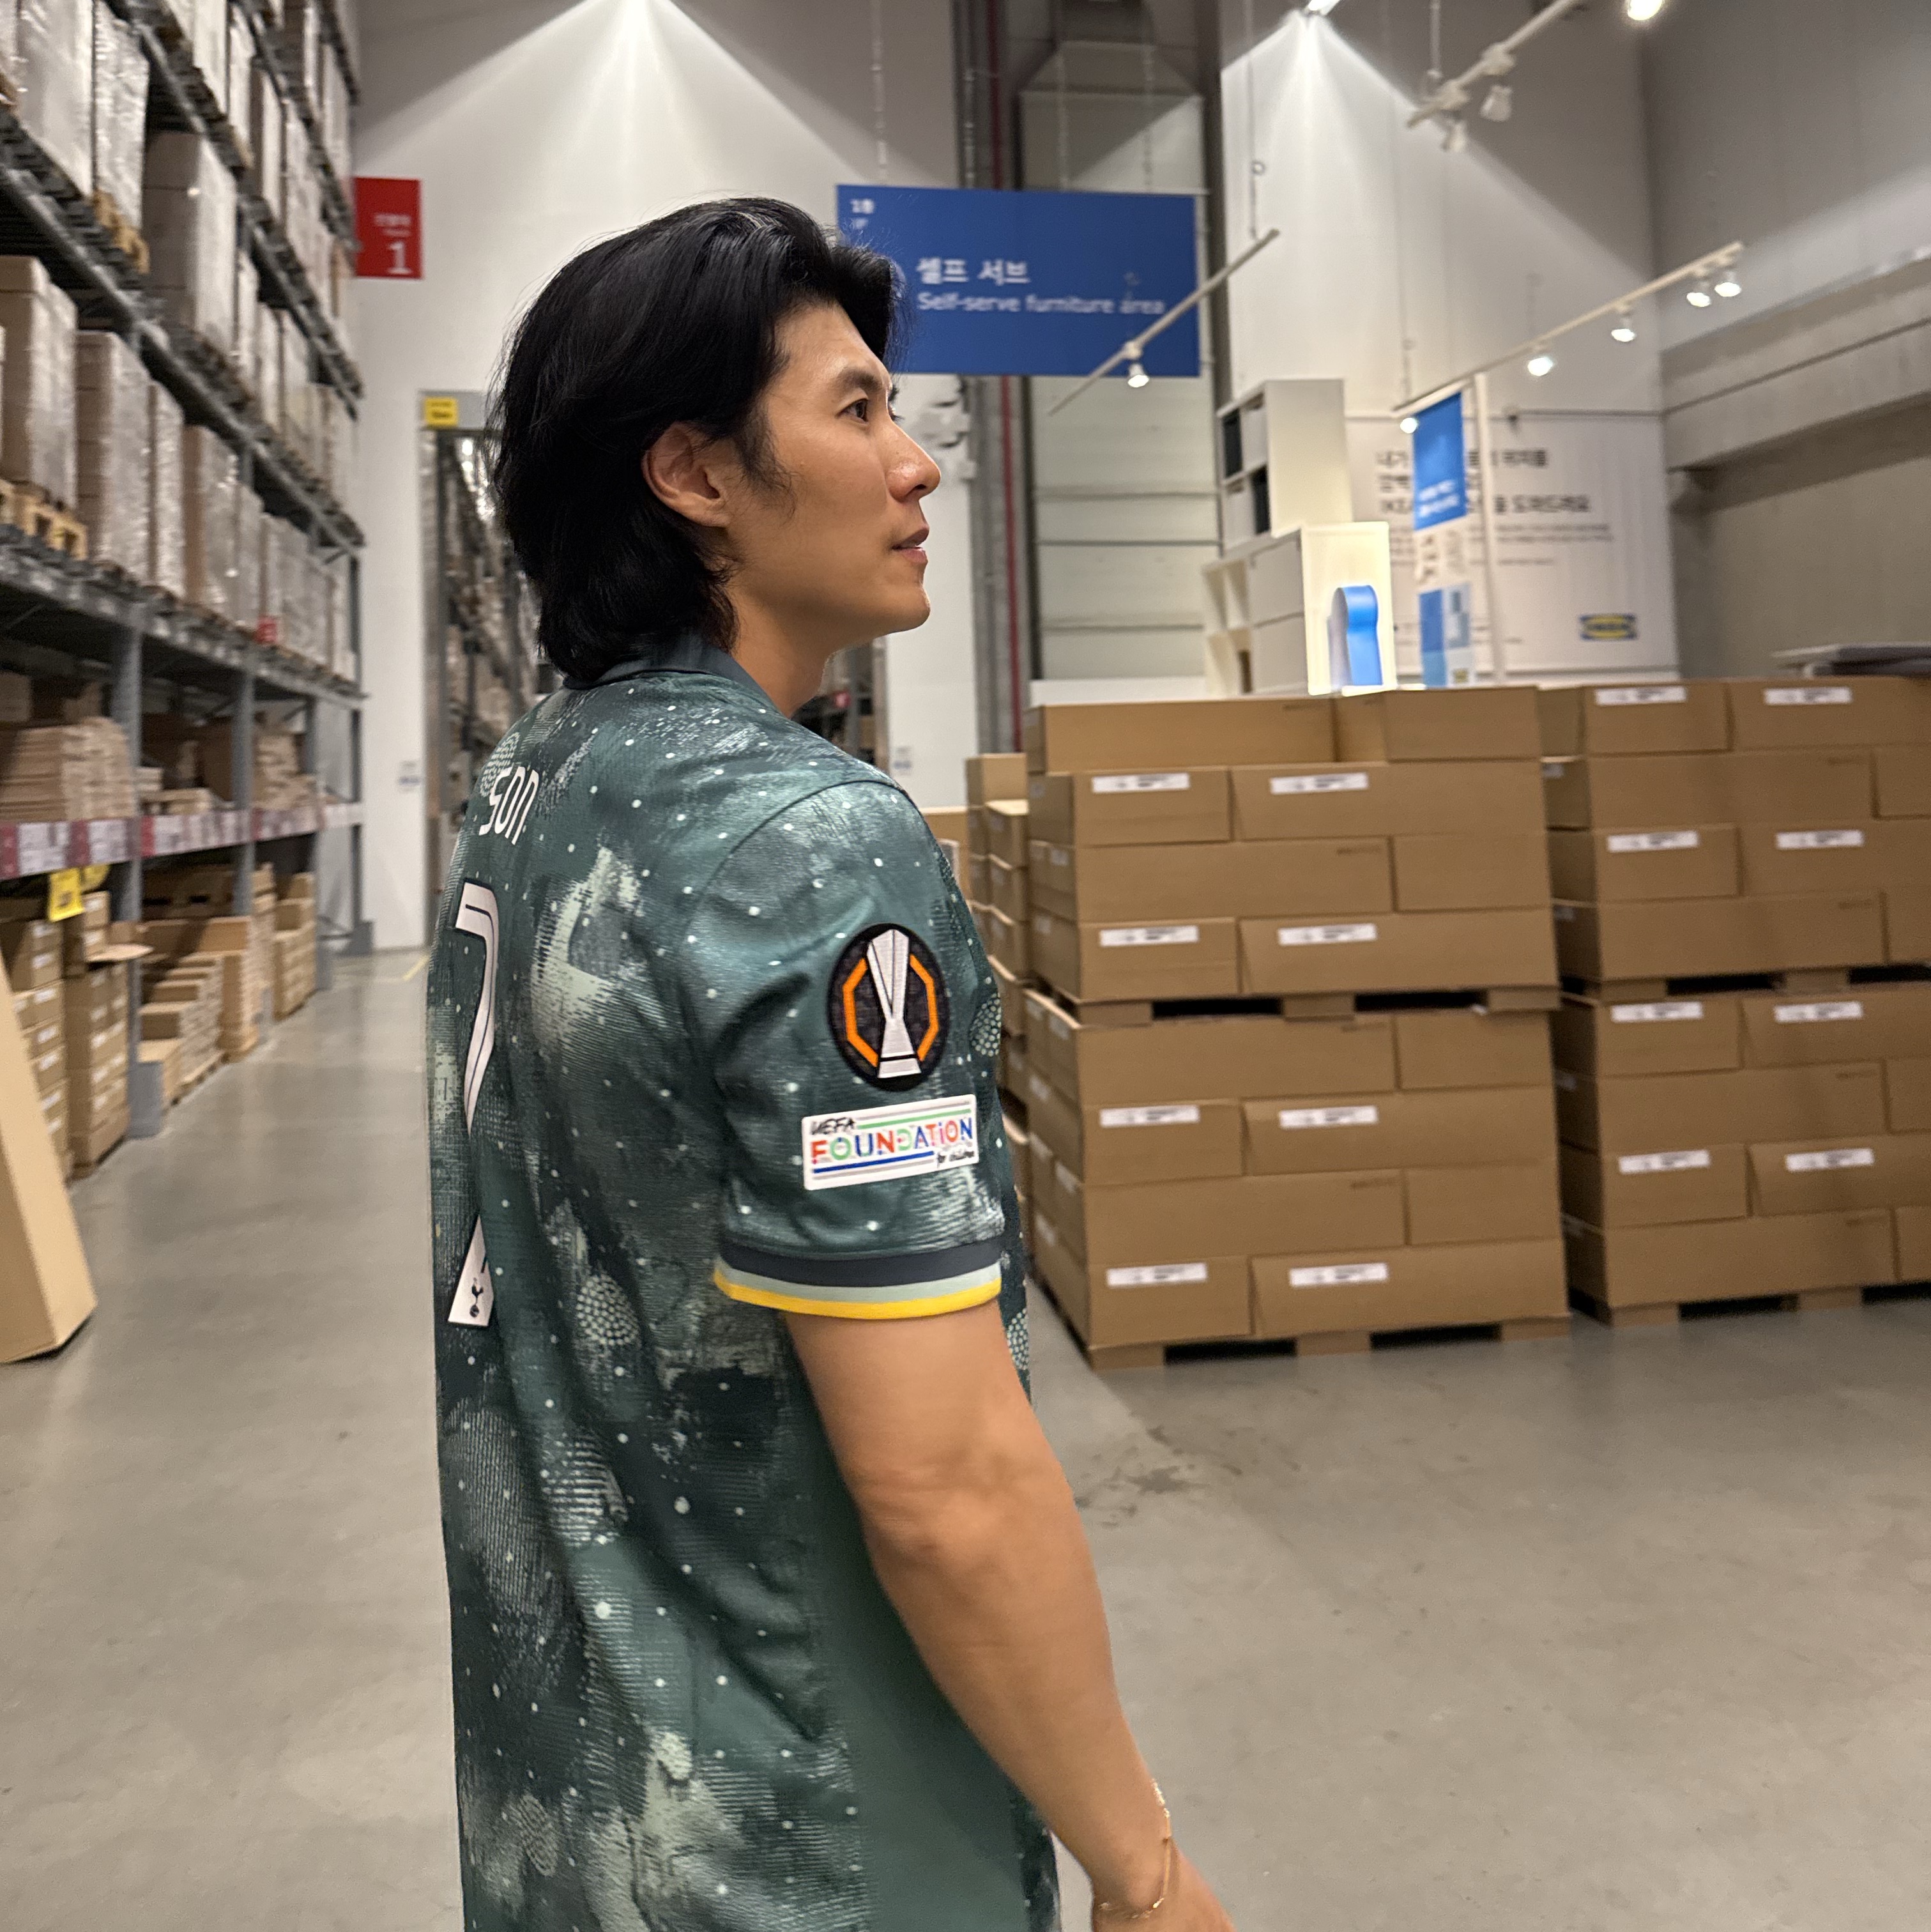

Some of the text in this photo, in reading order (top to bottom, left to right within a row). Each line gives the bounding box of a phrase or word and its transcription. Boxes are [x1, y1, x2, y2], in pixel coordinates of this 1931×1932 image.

[387, 240, 413, 275] 1
[917, 257, 1031, 286] 셀프 서브
[917, 292, 1166, 314] Self-serve furniture area
[811, 1117, 857, 1135] UEFA
